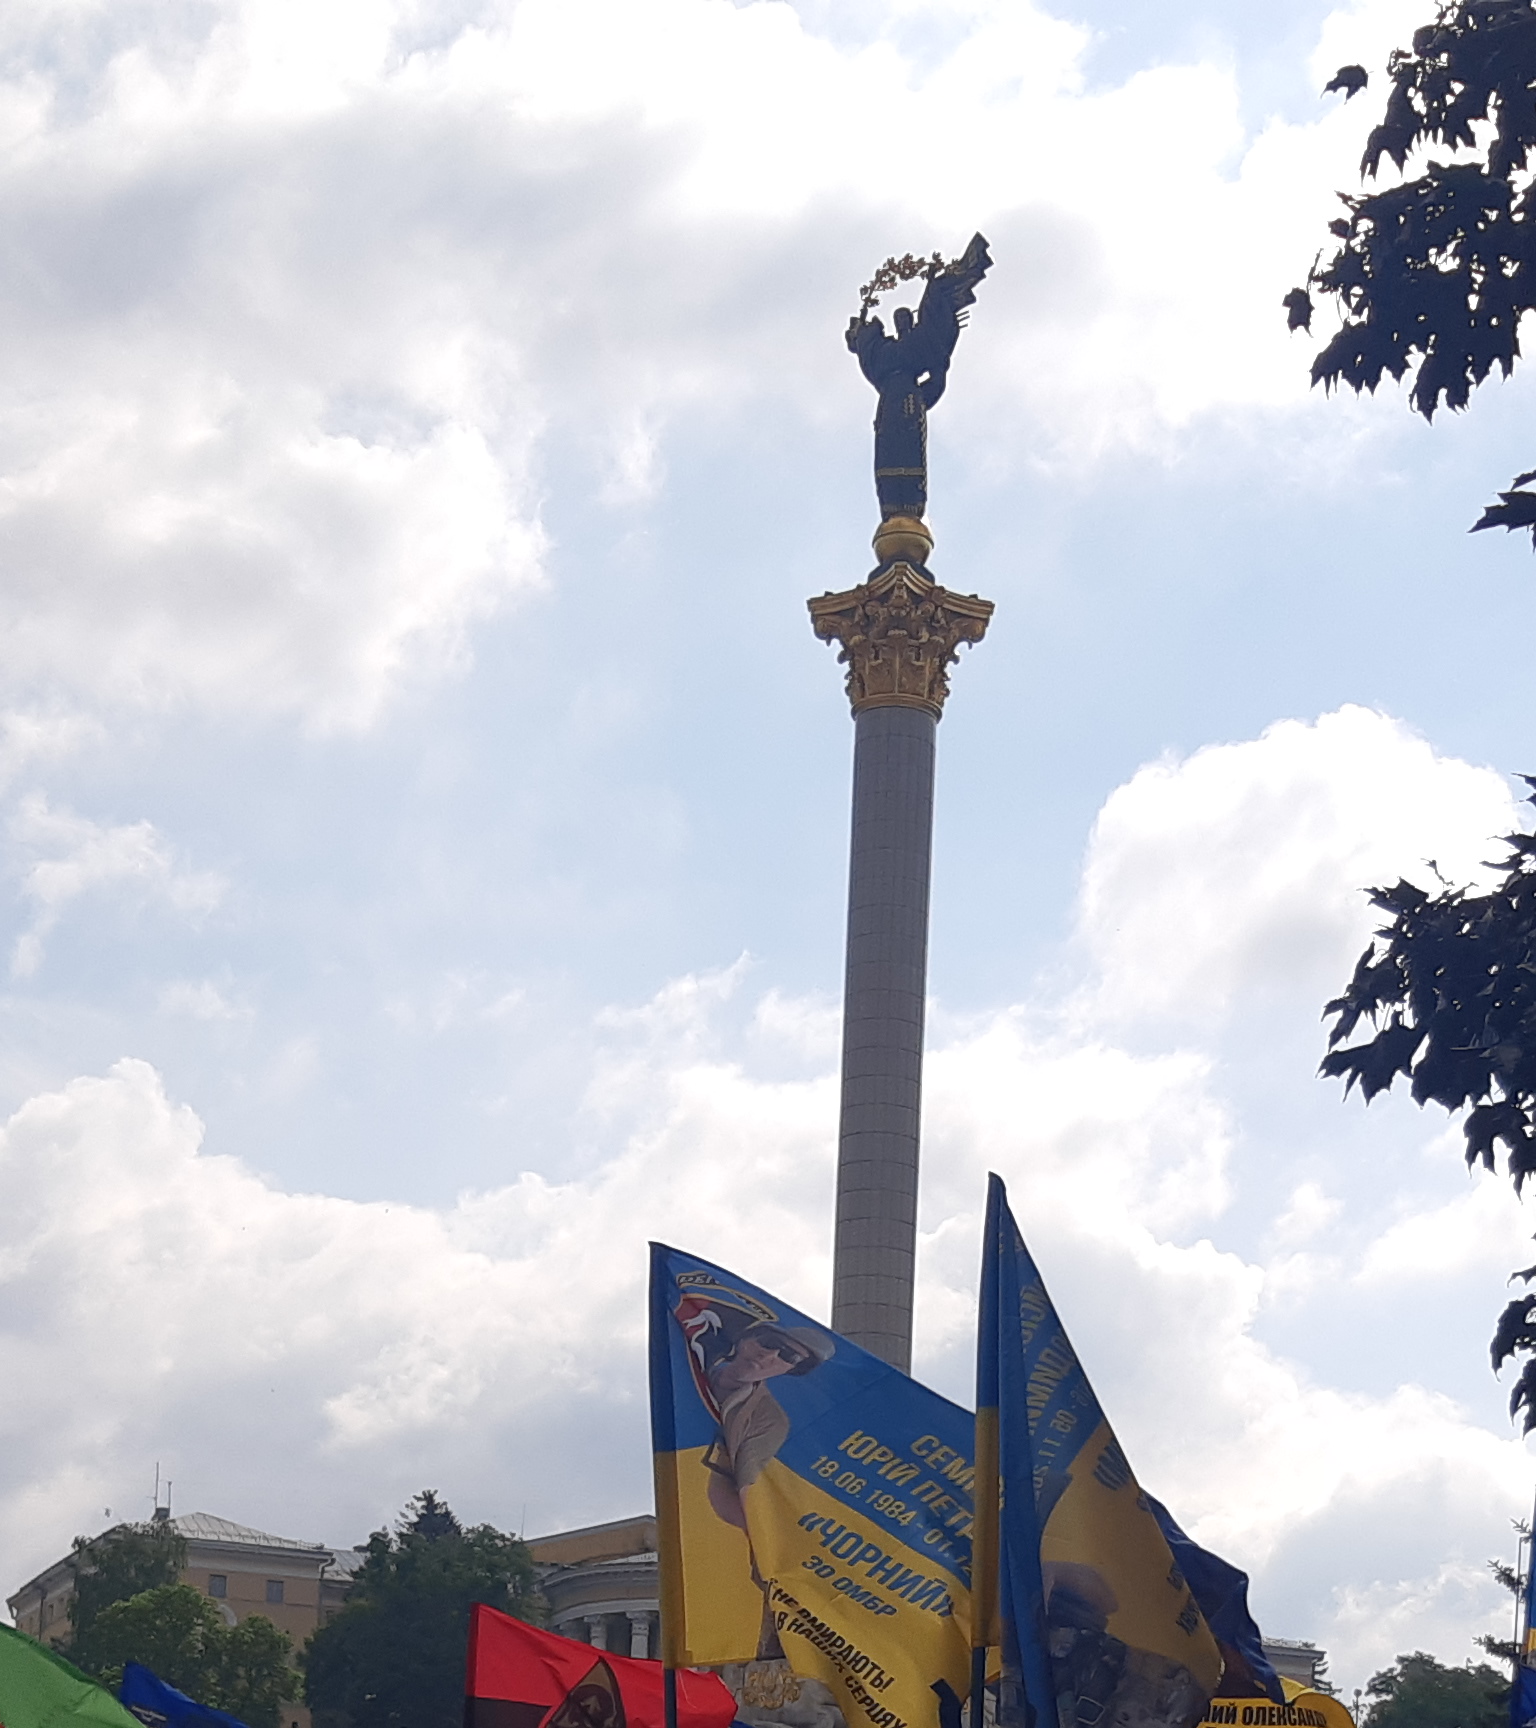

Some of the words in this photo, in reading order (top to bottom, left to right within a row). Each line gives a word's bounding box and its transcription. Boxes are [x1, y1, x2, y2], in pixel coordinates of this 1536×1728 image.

[837, 1430, 921, 1488] ЮРІЙ
[865, 1488, 919, 1527] 1984
[797, 1511, 954, 1618] «ЧОРНИЙ»
[801, 1555, 837, 1580] 30
[831, 1577, 898, 1617] ОМБР
